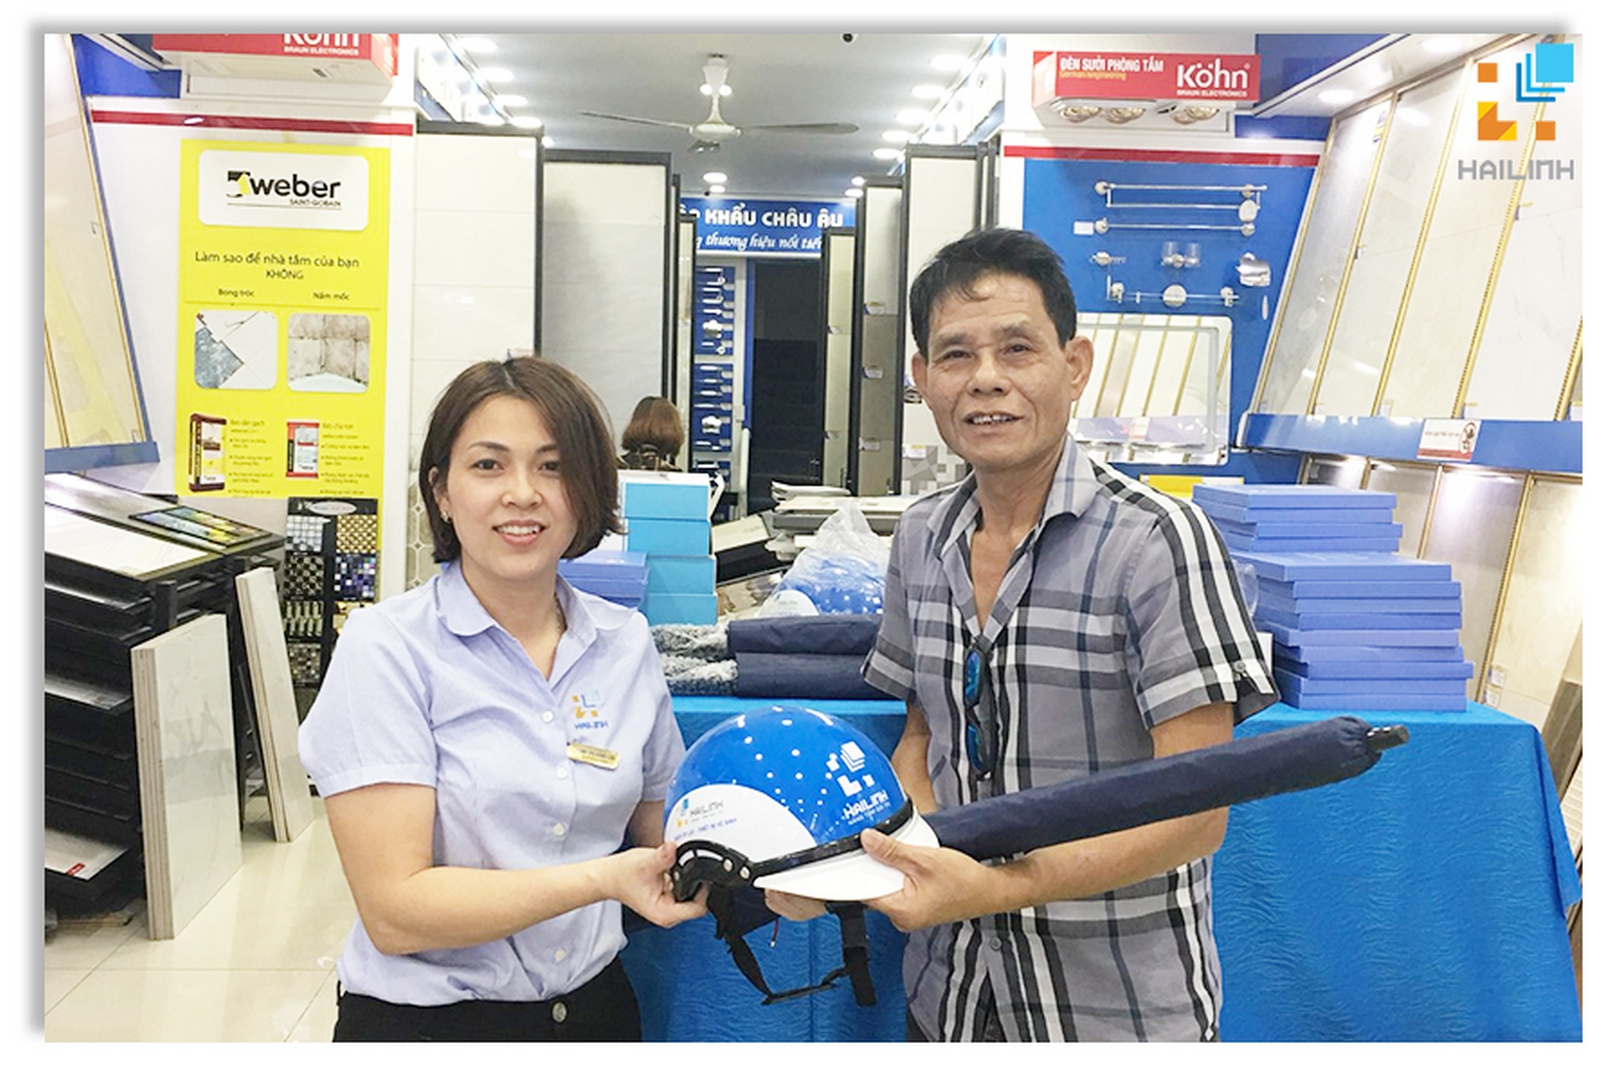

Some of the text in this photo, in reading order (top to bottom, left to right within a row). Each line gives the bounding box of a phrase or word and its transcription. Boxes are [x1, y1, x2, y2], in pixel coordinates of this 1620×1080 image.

[310, 47, 359, 56] ELECTRONICS
[1107, 57, 1140, 72] PHÒNG
[1177, 58, 1248, 89] Köhn
[250, 173, 341, 199] weber
[289, 199, 342, 208] SAINT-GOBAIN
[705, 202, 757, 226] KHẨU
[761, 207, 812, 227] CHÂU
[817, 207, 844, 229] ÂU
[195, 251, 220, 263] Làm
[222, 253, 244, 264] sao
[245, 252, 262, 266] để
[263, 253, 286, 266] nhà
[313, 256, 335, 268] của
[337, 257, 360, 270] bạn
[265, 269, 305, 281] KHÔNG
